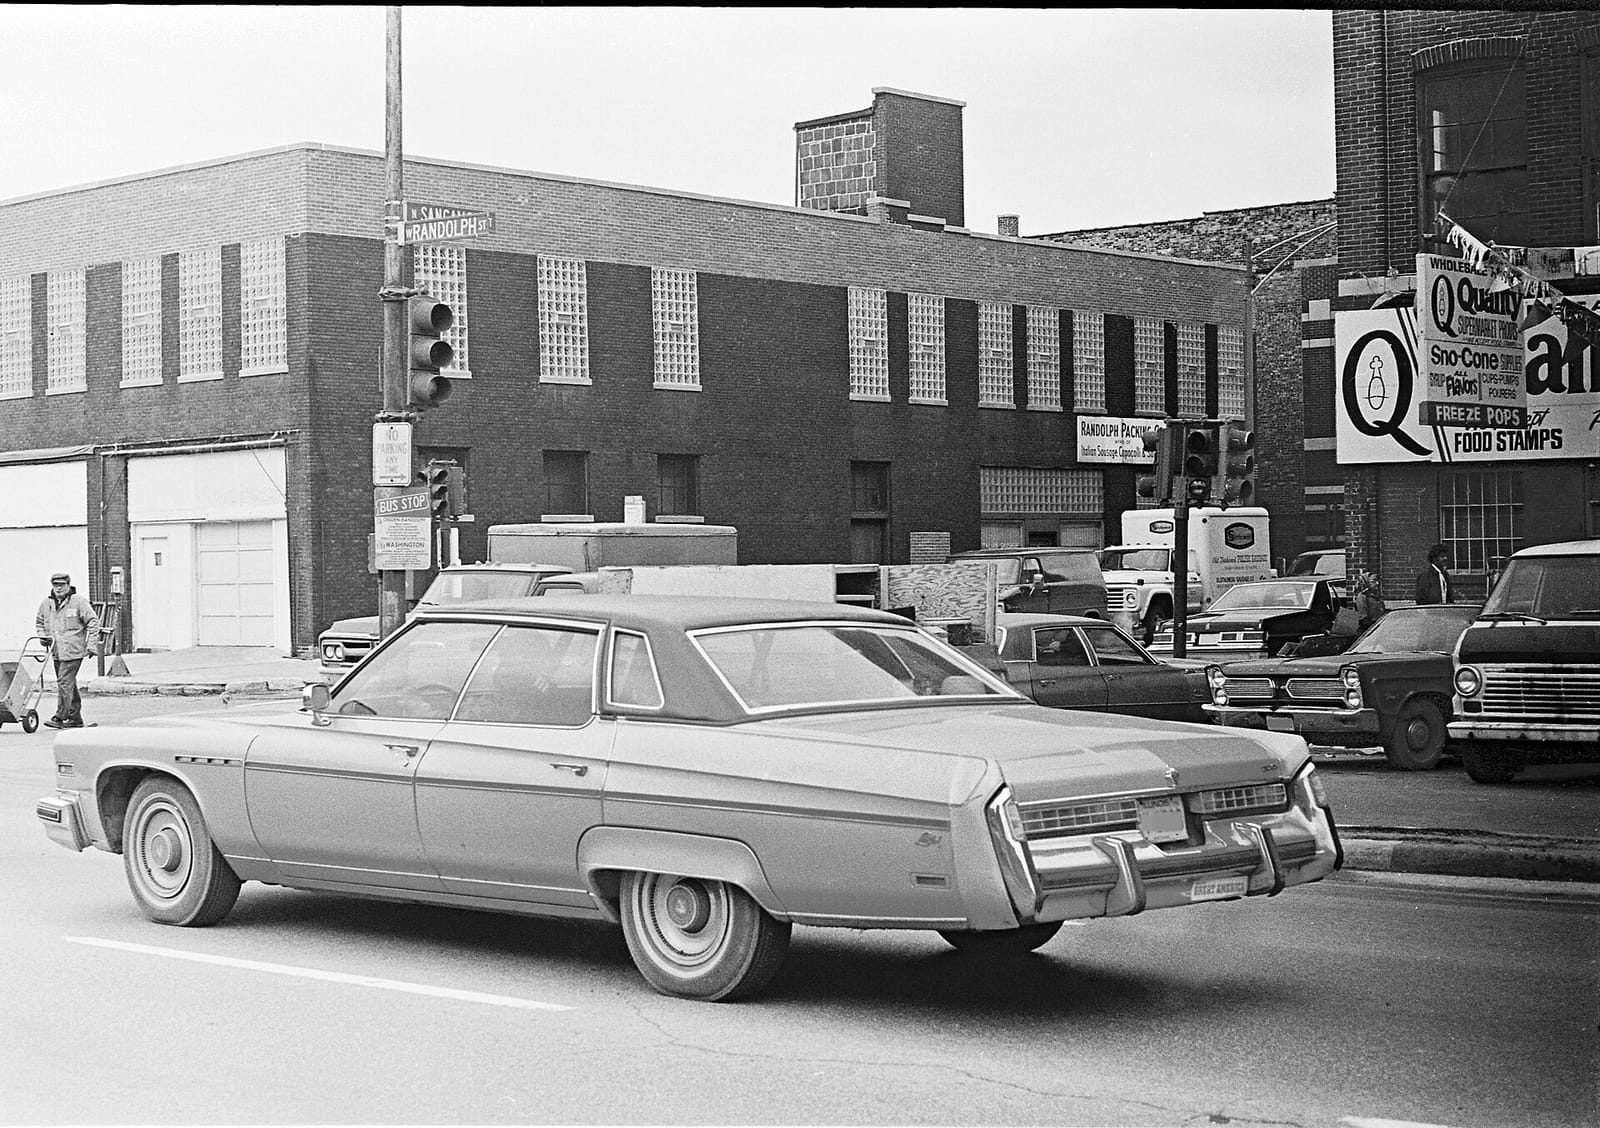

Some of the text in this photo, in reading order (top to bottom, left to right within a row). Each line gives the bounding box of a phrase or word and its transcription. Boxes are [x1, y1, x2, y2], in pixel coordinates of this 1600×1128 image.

[413, 217, 477, 241] RANDOLPH
[478, 219, 486, 231] ST
[1457, 276, 1523, 322] Quality
[1431, 344, 1499, 371] Sno-Cone
[1454, 370, 1469, 378] ALL
[1446, 374, 1478, 398] Flavors
[1489, 387, 1517, 400] POURERS
[1436, 405, 1520, 427] FREEZE POPS
[386, 429, 399, 441] NO
[1081, 421, 1119, 438] RANDOLPH
[376, 442, 407, 455] PARKING
[1454, 428, 1563, 453] FOOD STAMPS
[385, 455, 398, 465] ANY
[385, 465, 399, 474] TIME
[379, 494, 425, 514] BUS STOP
[1216, 880, 1247, 894] AMERICA
